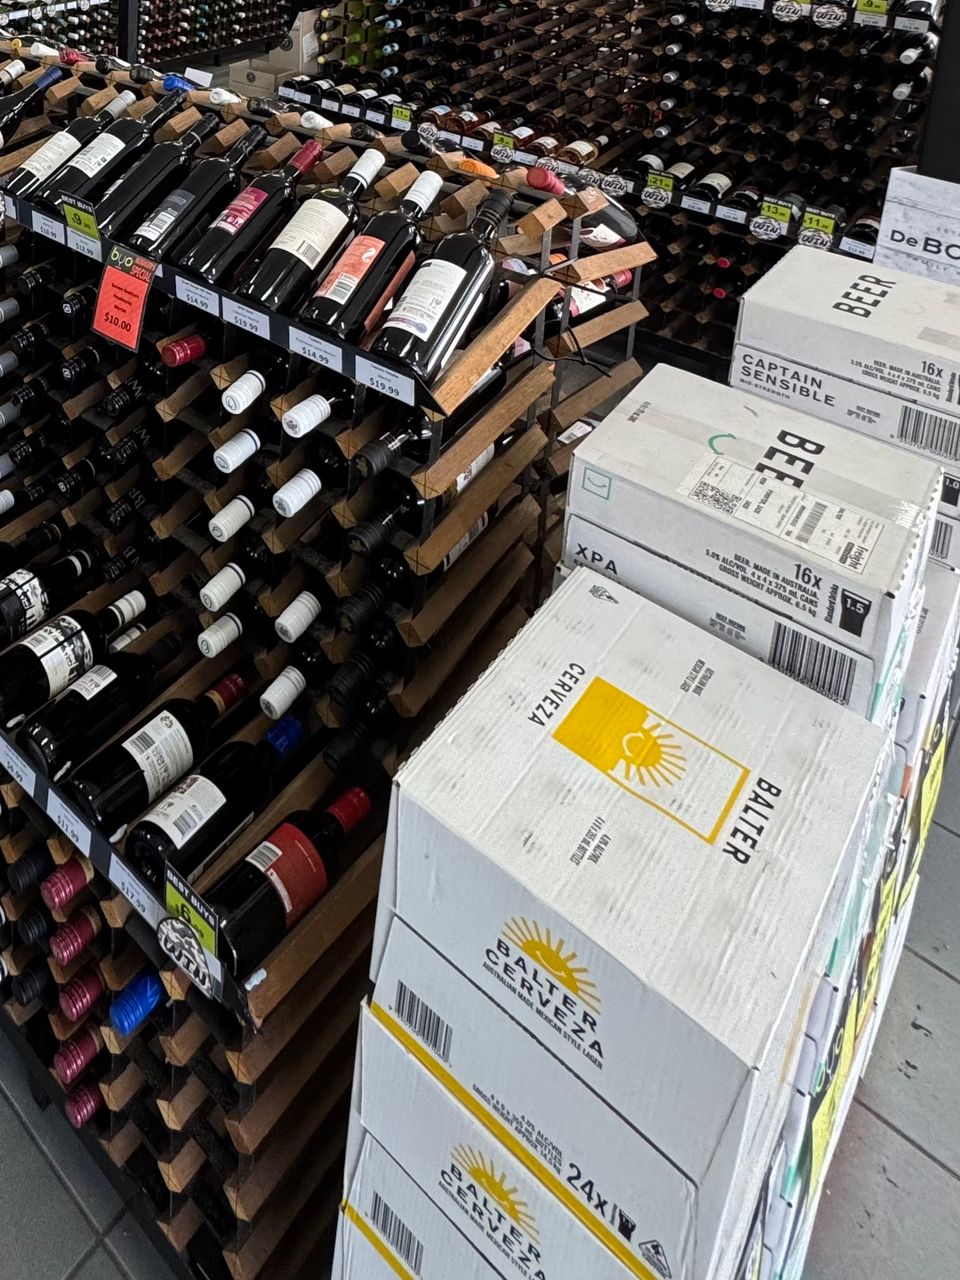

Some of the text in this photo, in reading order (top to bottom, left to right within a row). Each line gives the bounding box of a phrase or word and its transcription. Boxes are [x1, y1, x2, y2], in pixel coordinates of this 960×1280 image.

[774, 4, 800, 16] WIN
[815, 10, 842, 22] WIN
[492, 148, 513, 160] WIN
[604, 180, 626, 192] WIN
[644, 191, 669, 203] WIN
[62, 195, 76, 205] BEST
[752, 222, 779, 234] WIN
[890, 229, 918, 247] De
[76, 242, 94, 256] $12.99
[802, 234, 828, 248] WIN
[111, 246, 134, 267] byo
[186, 294, 209, 310] $14.99
[832, 274, 896, 319] BEER
[104, 312, 132, 332] $10.00
[234, 316, 258, 333] $19.99
[302, 346, 329, 364] $14.99
[742, 354, 824, 390] CAPTAIN
[879, 374, 899, 386] WEIGHT
[888, 365, 904, 374] MADE
[921, 361, 944, 379] 16x
[369, 378, 400, 397] $19.99
[741, 365, 836, 408] SENSIBLE
[576, 543, 618, 575] XPA
[734, 553, 752, 568] BEER.
[753, 562, 772, 578] MADE
[772, 571, 780, 581] IN
[705, 548, 720, 562] 5.0%
[721, 556, 748, 574] ALC/VOL
[774, 581, 787, 593] 375
[800, 592, 818, 608] CANS
[794, 563, 823, 590] 16x
[718, 564, 739, 580] GROSS
[740, 572, 765, 591] WEIGHT
[808, 606, 817, 618] kg
[846, 598, 864, 614] 1.5
[527, 662, 586, 728] CERVEZA
[57, 814, 80, 844] $11.99
[722, 777, 782, 865] BALTER
[570, 843, 588, 866] BOTTLES
[120, 882, 146, 914] $17.99
[166, 870, 215, 926] BEST BUYS
[163, 935, 207, 987] WIN
[496, 938, 598, 1034] BALTER
[482, 961, 604, 1070] AUSTRALIAN MADE MEXICAN STYLE LAGER
[485, 948, 604, 1060] CERVEZA
[492, 1102, 514, 1127] WEIGHT
[534, 1136, 562, 1168] BOTTLES
[566, 1162, 609, 1216] 24x
[438, 1180, 469, 1216] AUSTRALIAN
[470, 1214, 484, 1232] MADE
[486, 1230, 511, 1259] MEXICAN
[450, 1163, 541, 1264] BALTER
